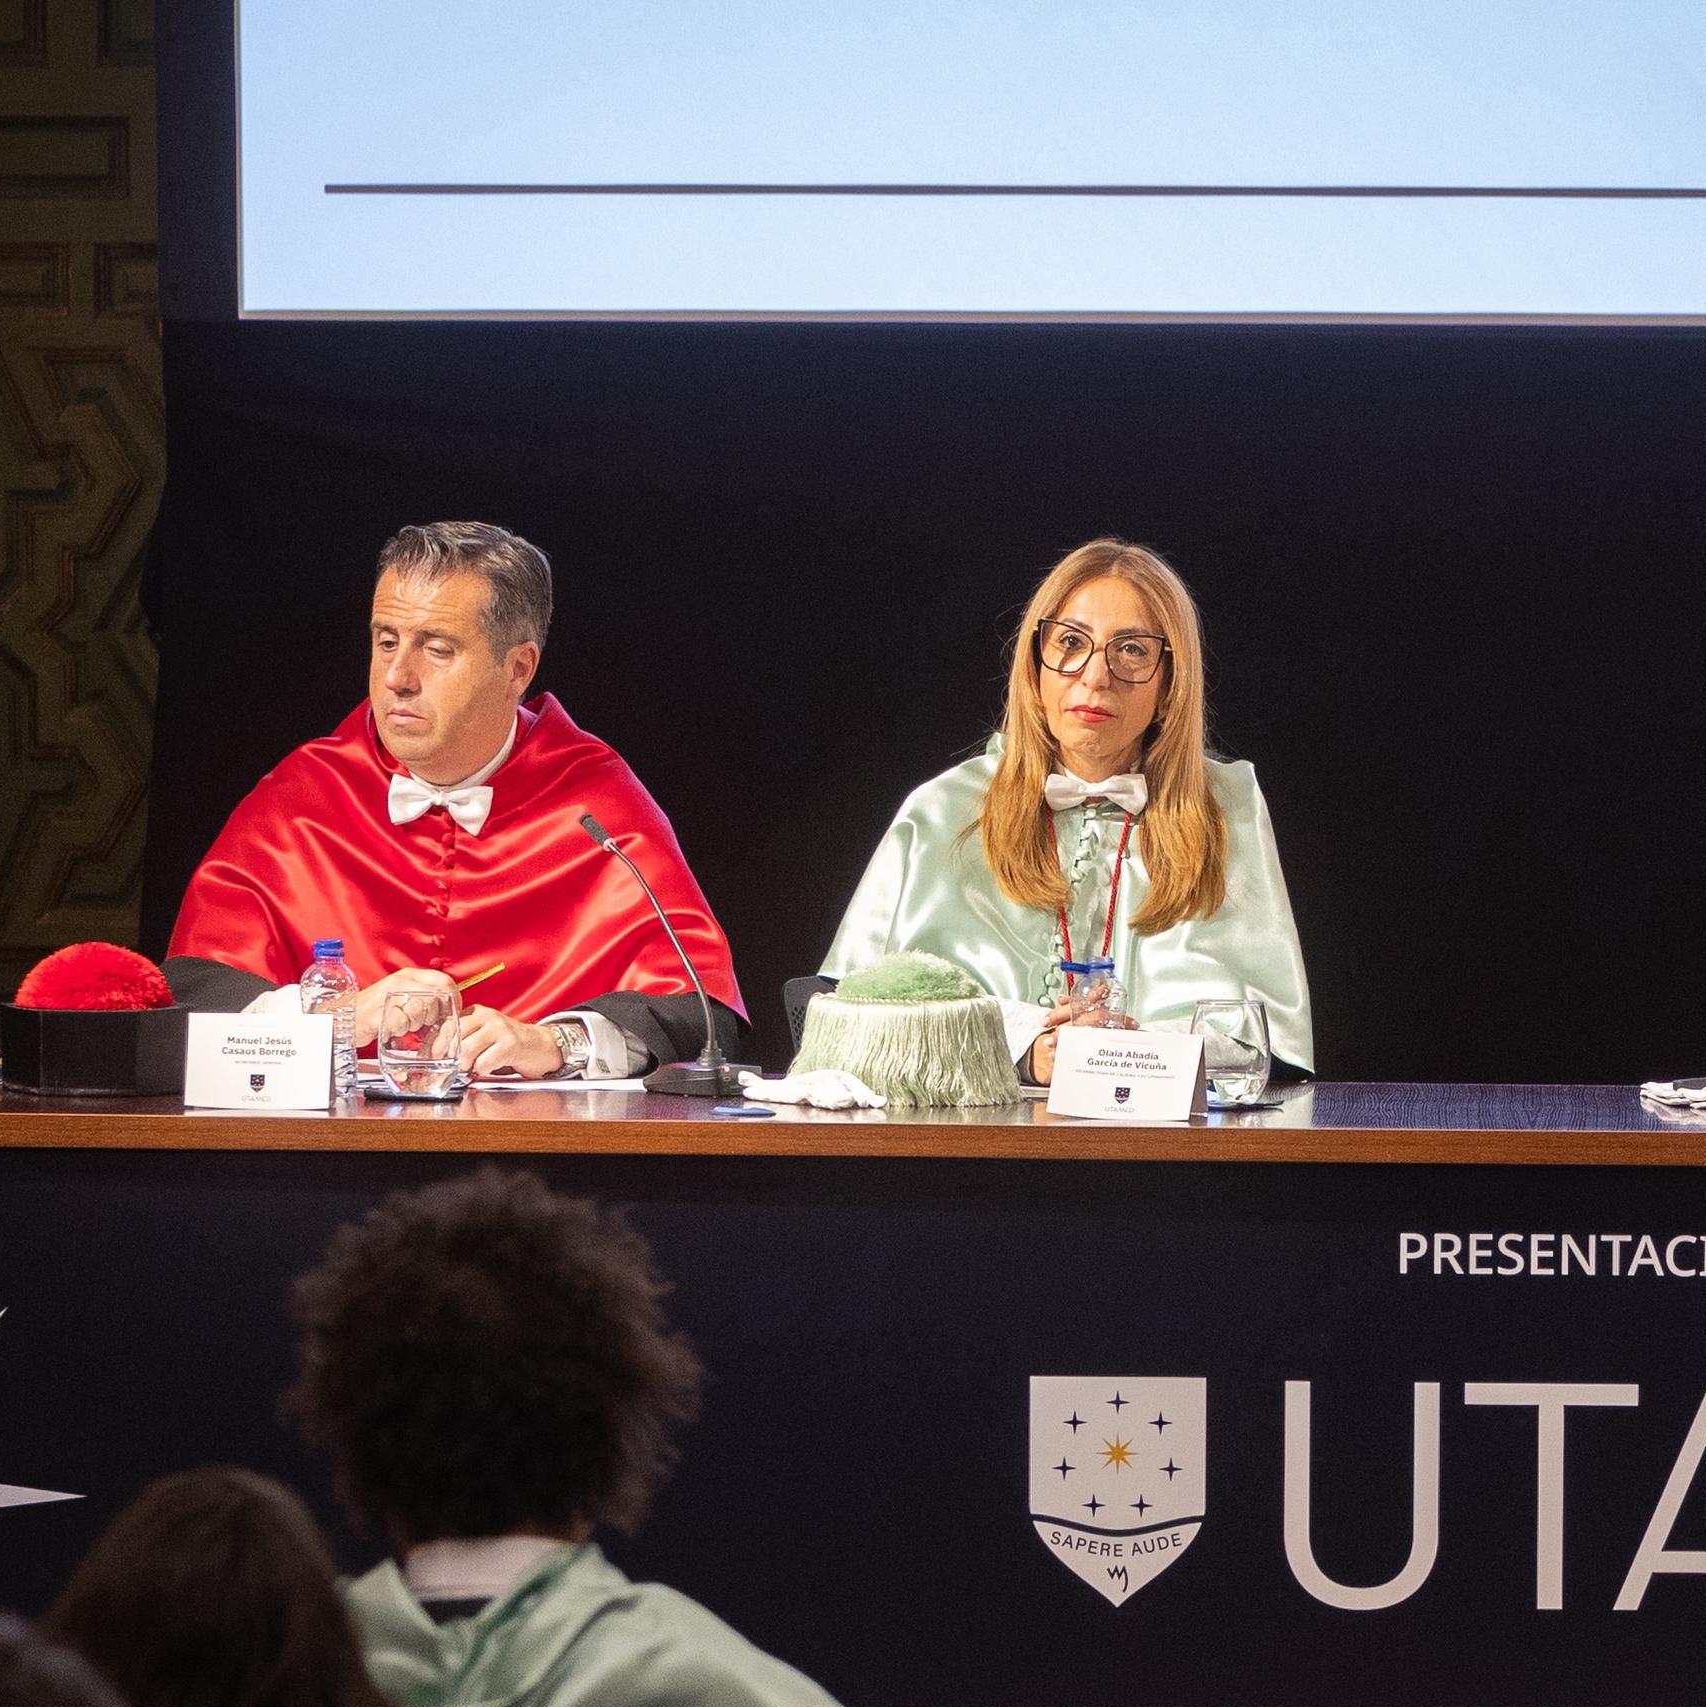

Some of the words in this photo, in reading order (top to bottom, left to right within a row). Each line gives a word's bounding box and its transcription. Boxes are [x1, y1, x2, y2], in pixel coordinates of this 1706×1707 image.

[227, 1036, 262, 1045] Manuel
[221, 1046, 256, 1055] Casaus
[259, 1047, 297, 1058] Borrego
[1120, 1060, 1132, 1068] de
[1135, 1061, 1167, 1071] Vicuña
[1050, 1531, 1124, 1557] SAPERE
[1131, 1532, 1183, 1557] AUDE
